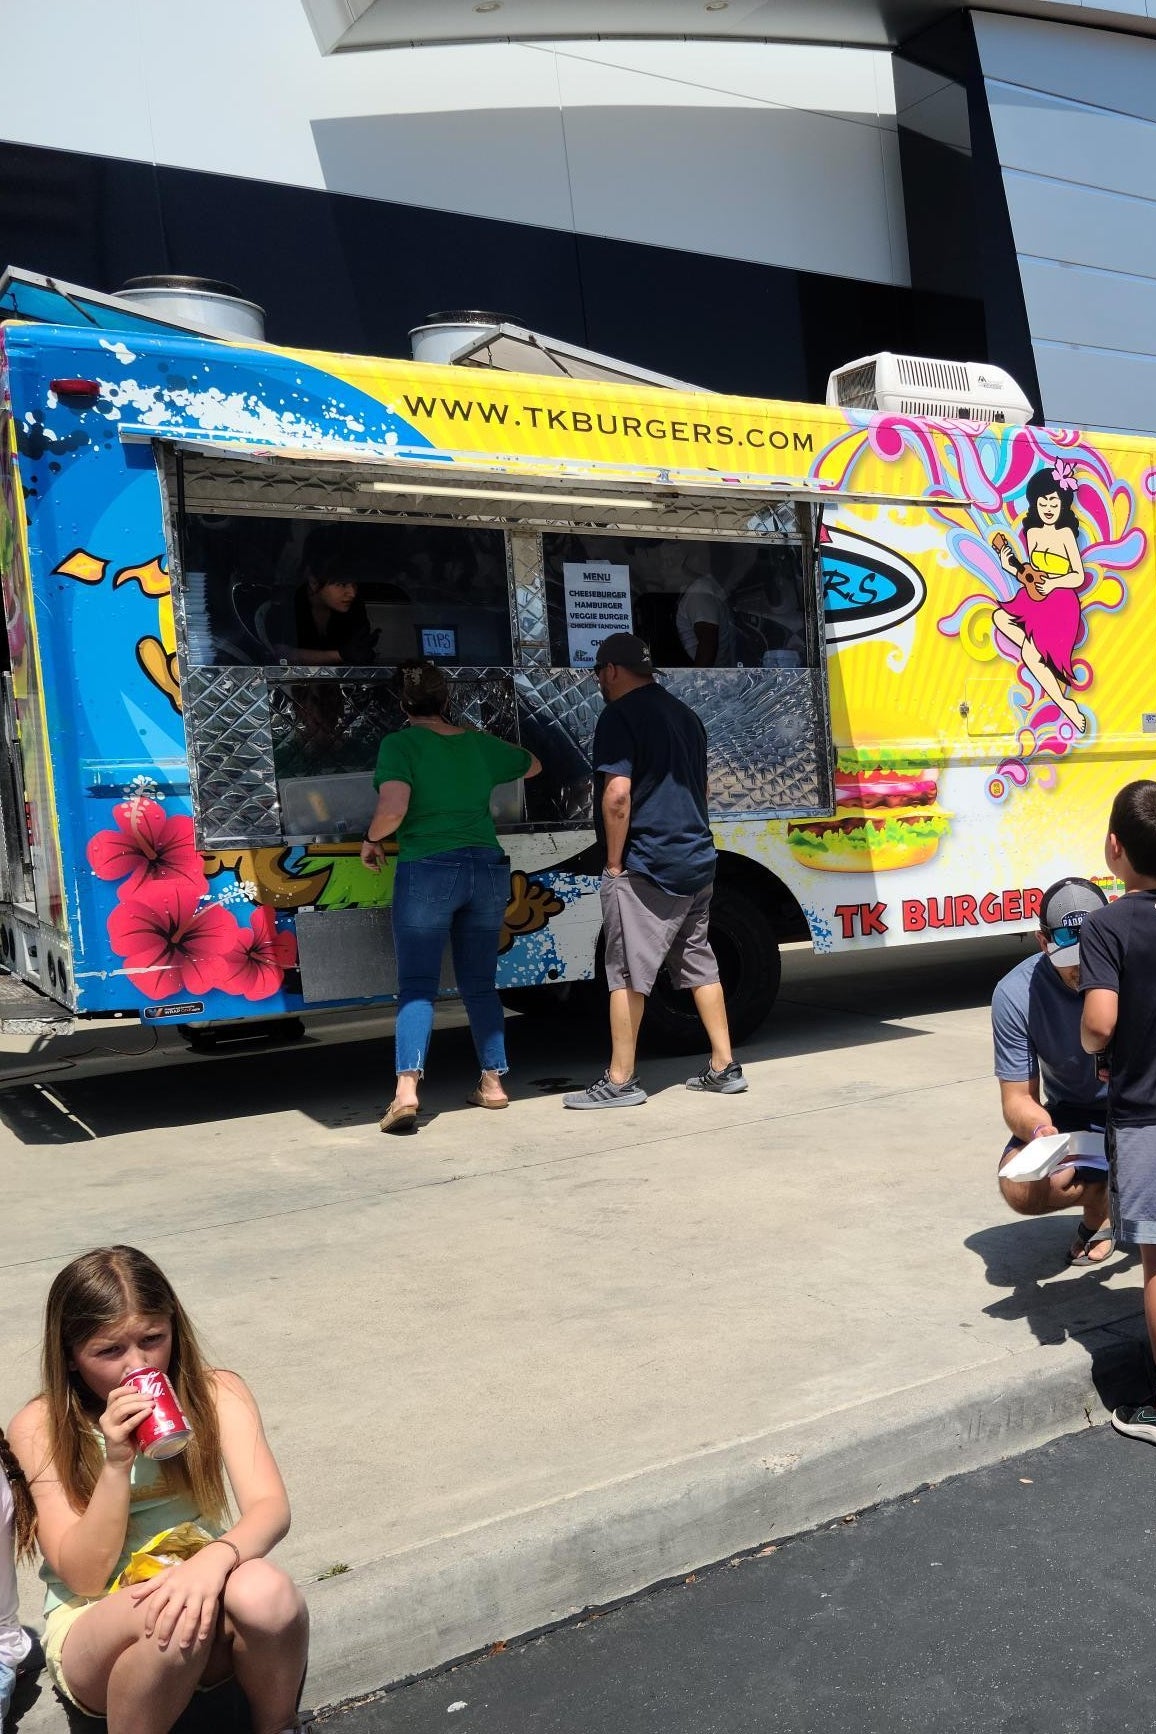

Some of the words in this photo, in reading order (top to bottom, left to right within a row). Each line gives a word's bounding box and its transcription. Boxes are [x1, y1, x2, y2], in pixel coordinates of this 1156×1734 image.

[402, 394, 815, 453] WWW.TKBURGERS.COM
[583, 572, 611, 582] MENU
[568, 590, 627, 599] CHEESEBURGER
[574, 601, 623, 609] HAMBURGER
[569, 612, 598, 620] VEGGIE
[599, 613, 629, 621] BURGER
[834, 902, 889, 939] TK
[902, 888, 1044, 932] BURGER
